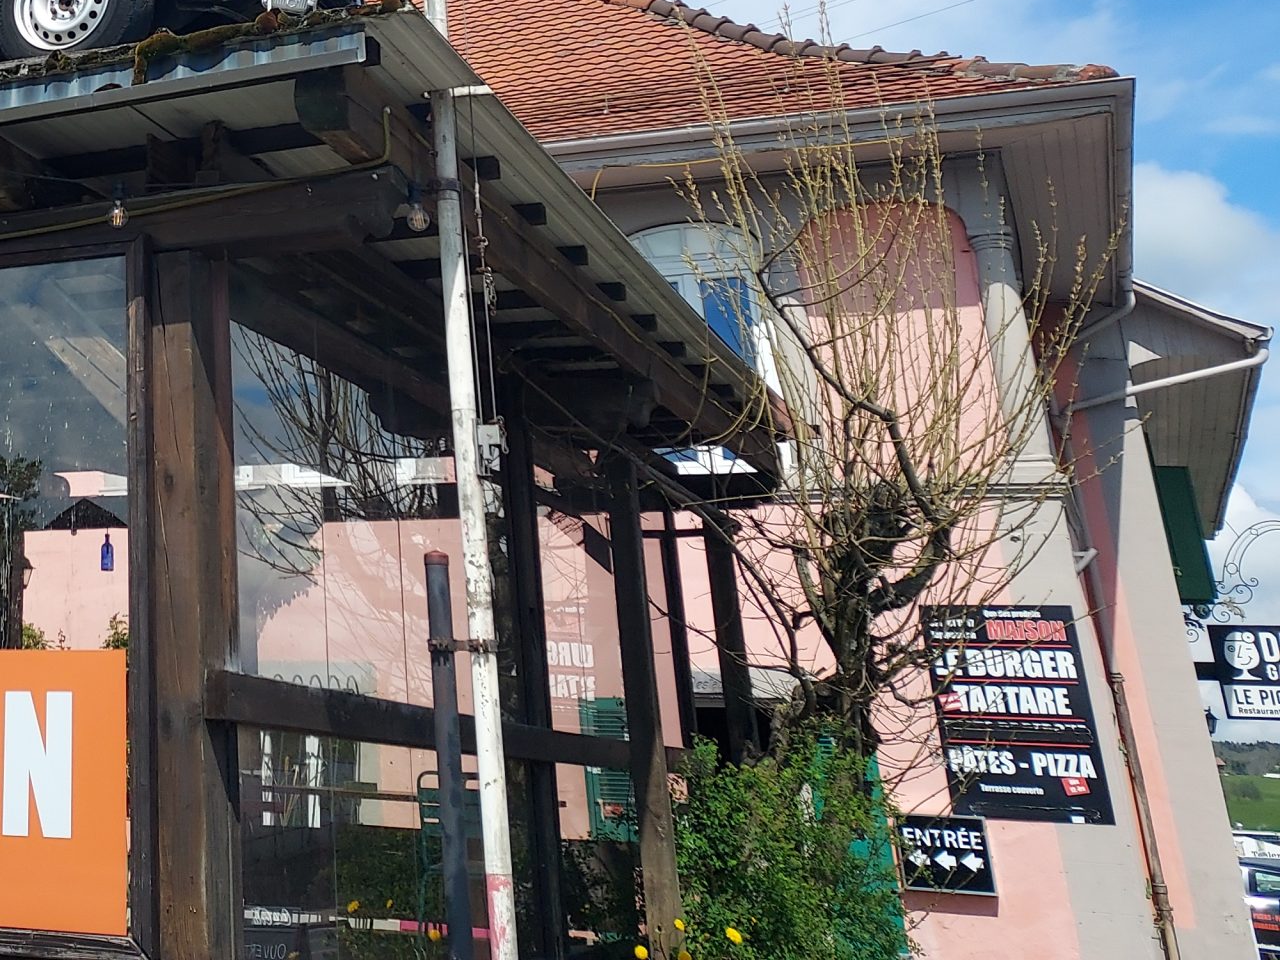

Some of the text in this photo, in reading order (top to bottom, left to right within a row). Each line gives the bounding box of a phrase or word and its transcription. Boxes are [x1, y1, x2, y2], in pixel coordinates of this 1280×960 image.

[985, 619, 1067, 642] MAISON
[965, 649, 1078, 679] BURGER
[951, 684, 1073, 716] TARTARE
[1233, 689, 1254, 705] LE
[1031, 752, 1098, 779] PIZZA
[902, 827, 983, 850] ENTRÉE
